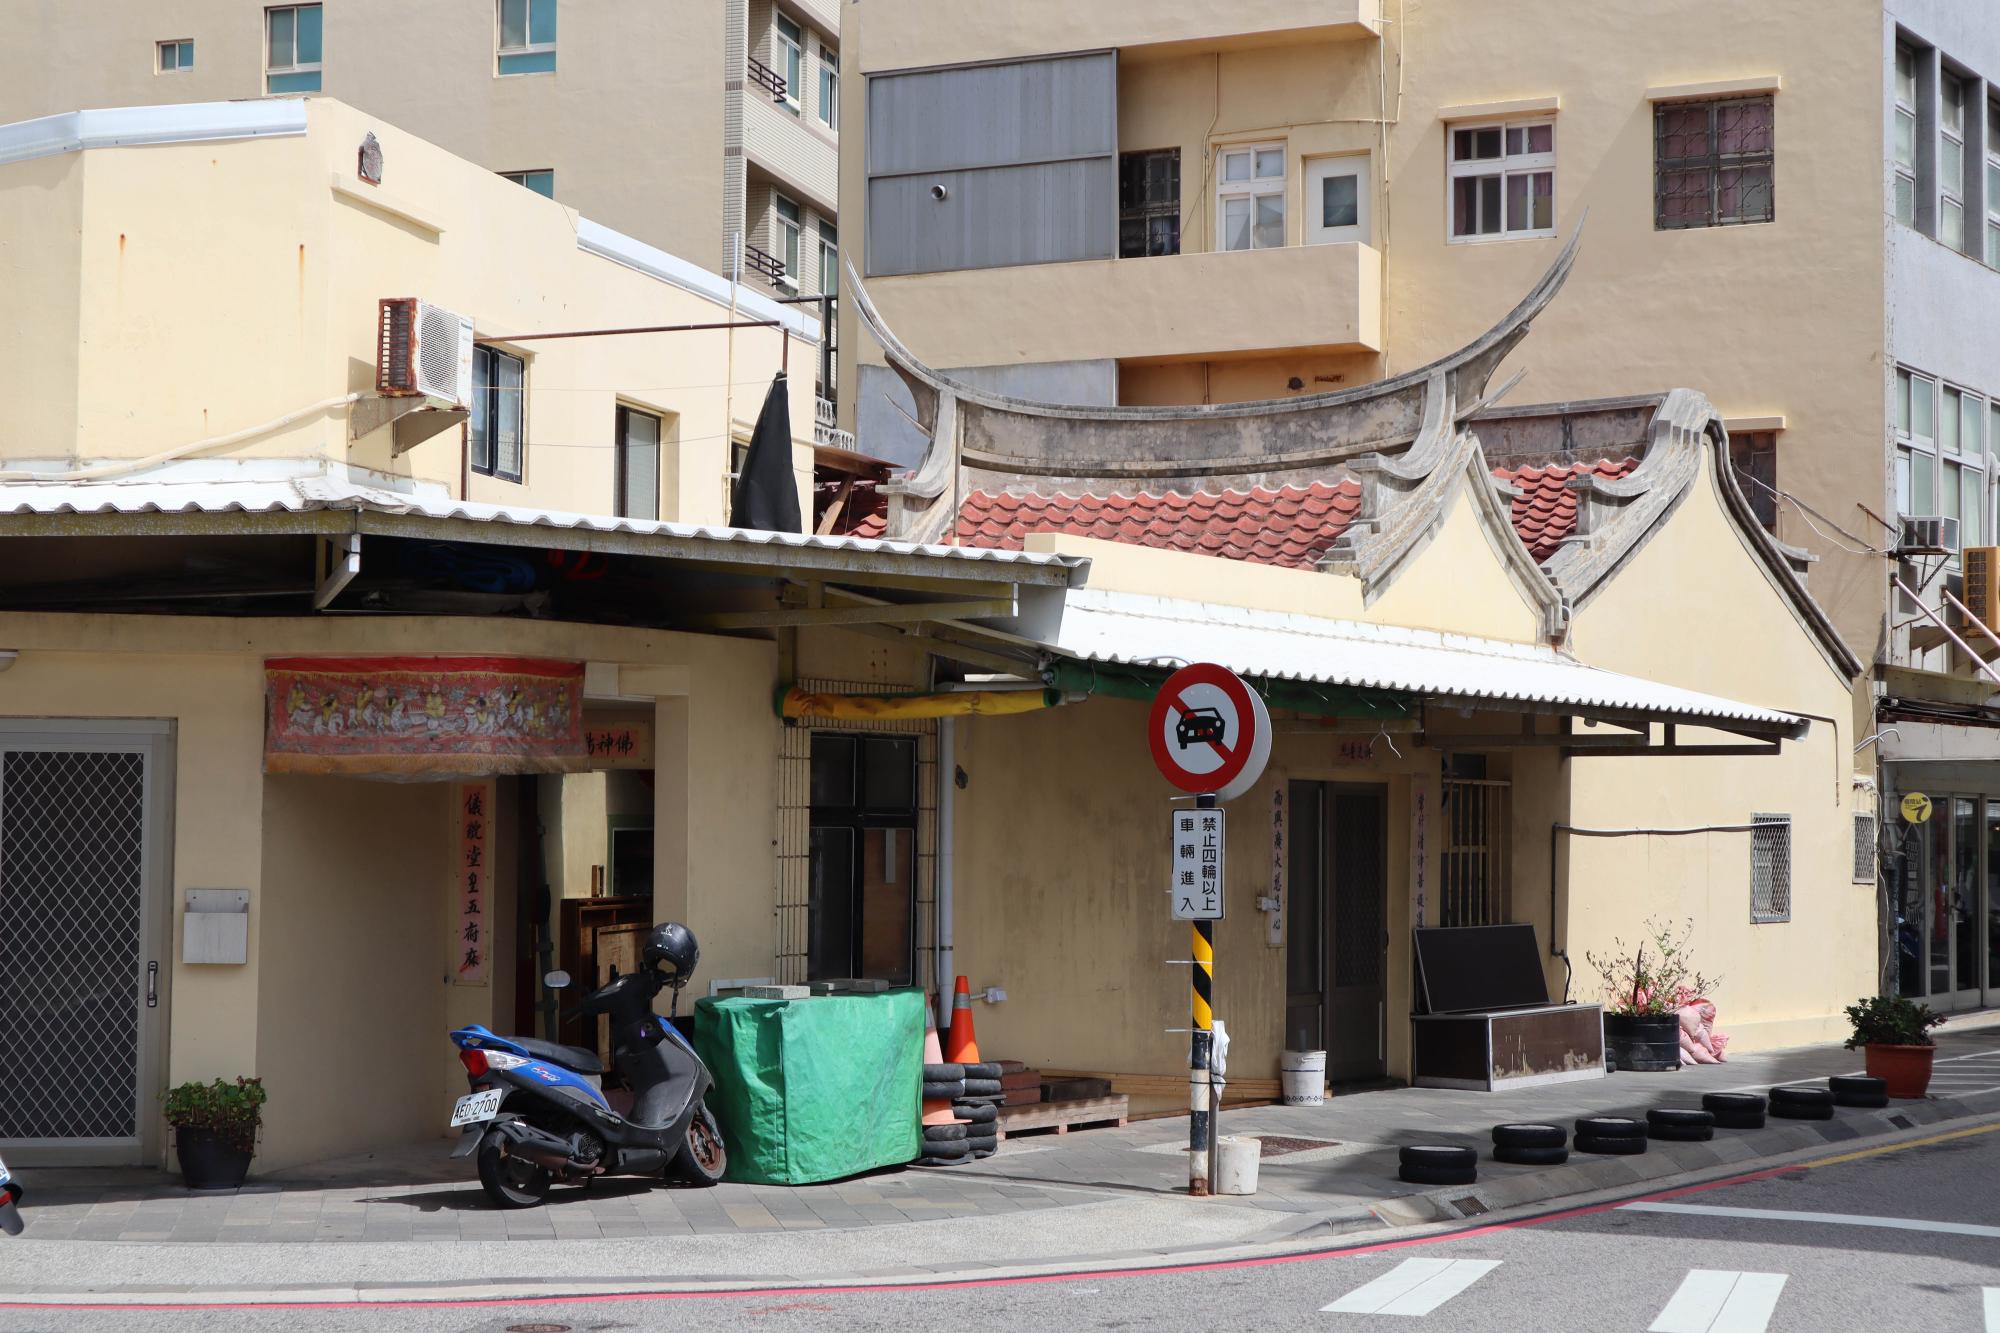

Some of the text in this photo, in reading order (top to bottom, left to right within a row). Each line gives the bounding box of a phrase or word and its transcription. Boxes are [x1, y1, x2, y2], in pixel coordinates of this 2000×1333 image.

[1180, 818, 1195, 912] 車輛進入
[1202, 817, 1217, 911] 禁止四輪以上
